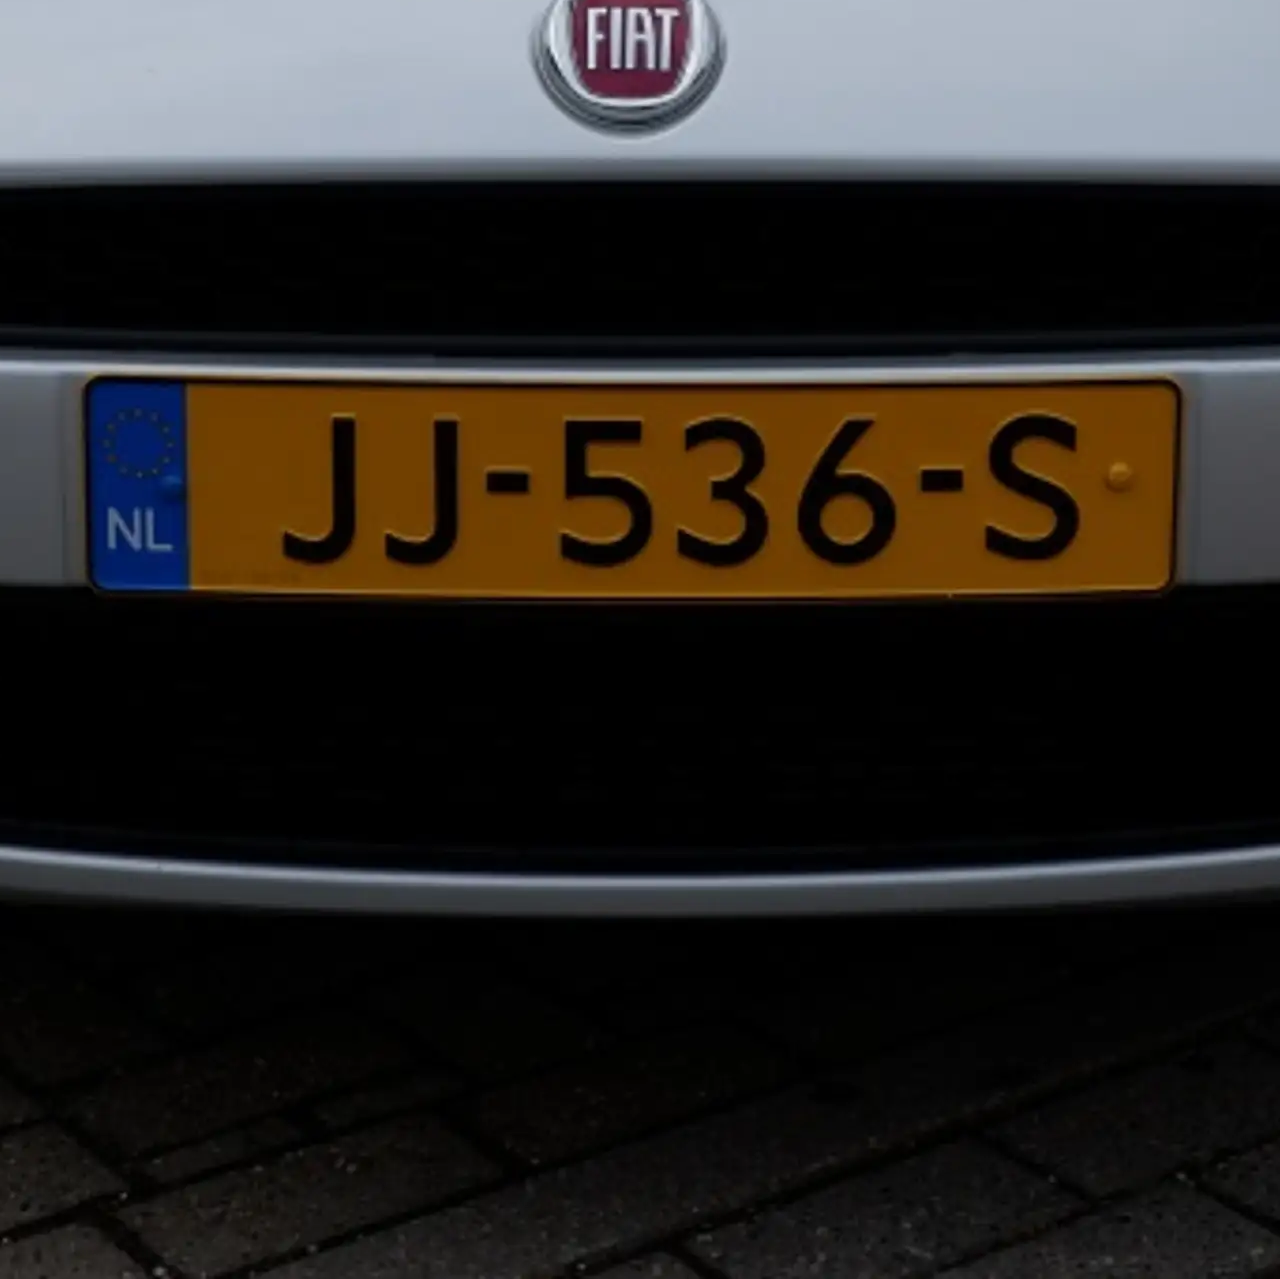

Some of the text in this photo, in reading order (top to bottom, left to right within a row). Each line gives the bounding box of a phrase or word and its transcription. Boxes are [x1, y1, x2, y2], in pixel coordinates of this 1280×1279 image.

[586, 6, 681, 71] FIAT
[281, 412, 1081, 568] JJ-536-S
[106, 506, 174, 552] NL
